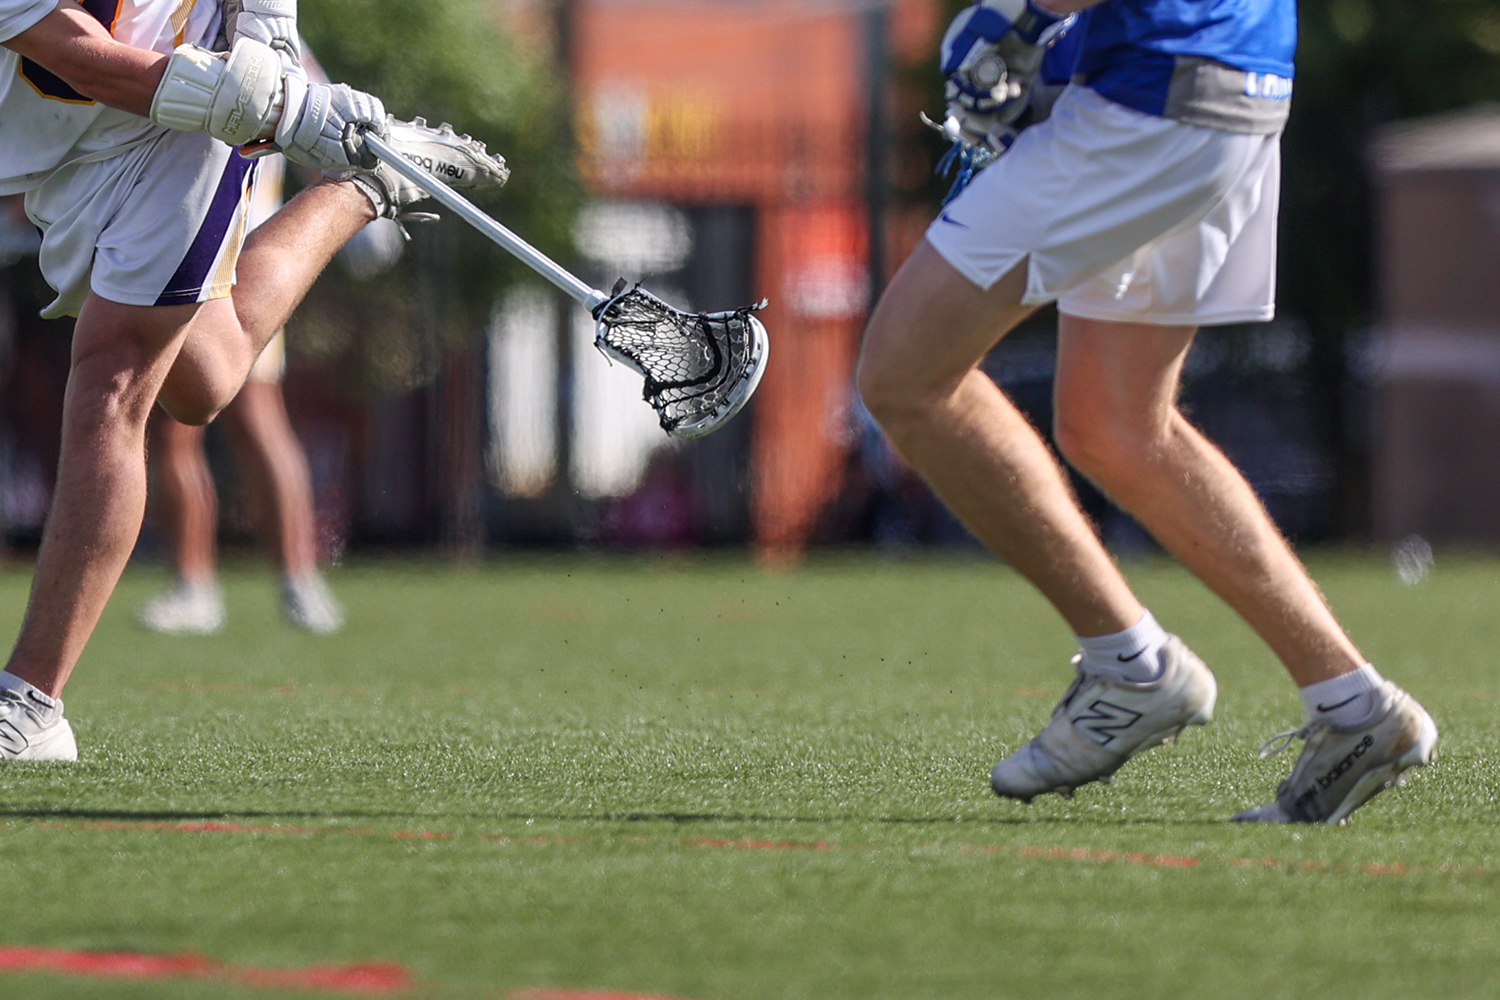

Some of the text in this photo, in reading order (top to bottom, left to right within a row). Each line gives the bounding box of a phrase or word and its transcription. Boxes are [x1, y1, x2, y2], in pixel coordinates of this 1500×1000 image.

[222, 55, 265, 135] MAVERIK
[435, 158, 465, 179] new
[1316, 734, 1375, 790] balance
